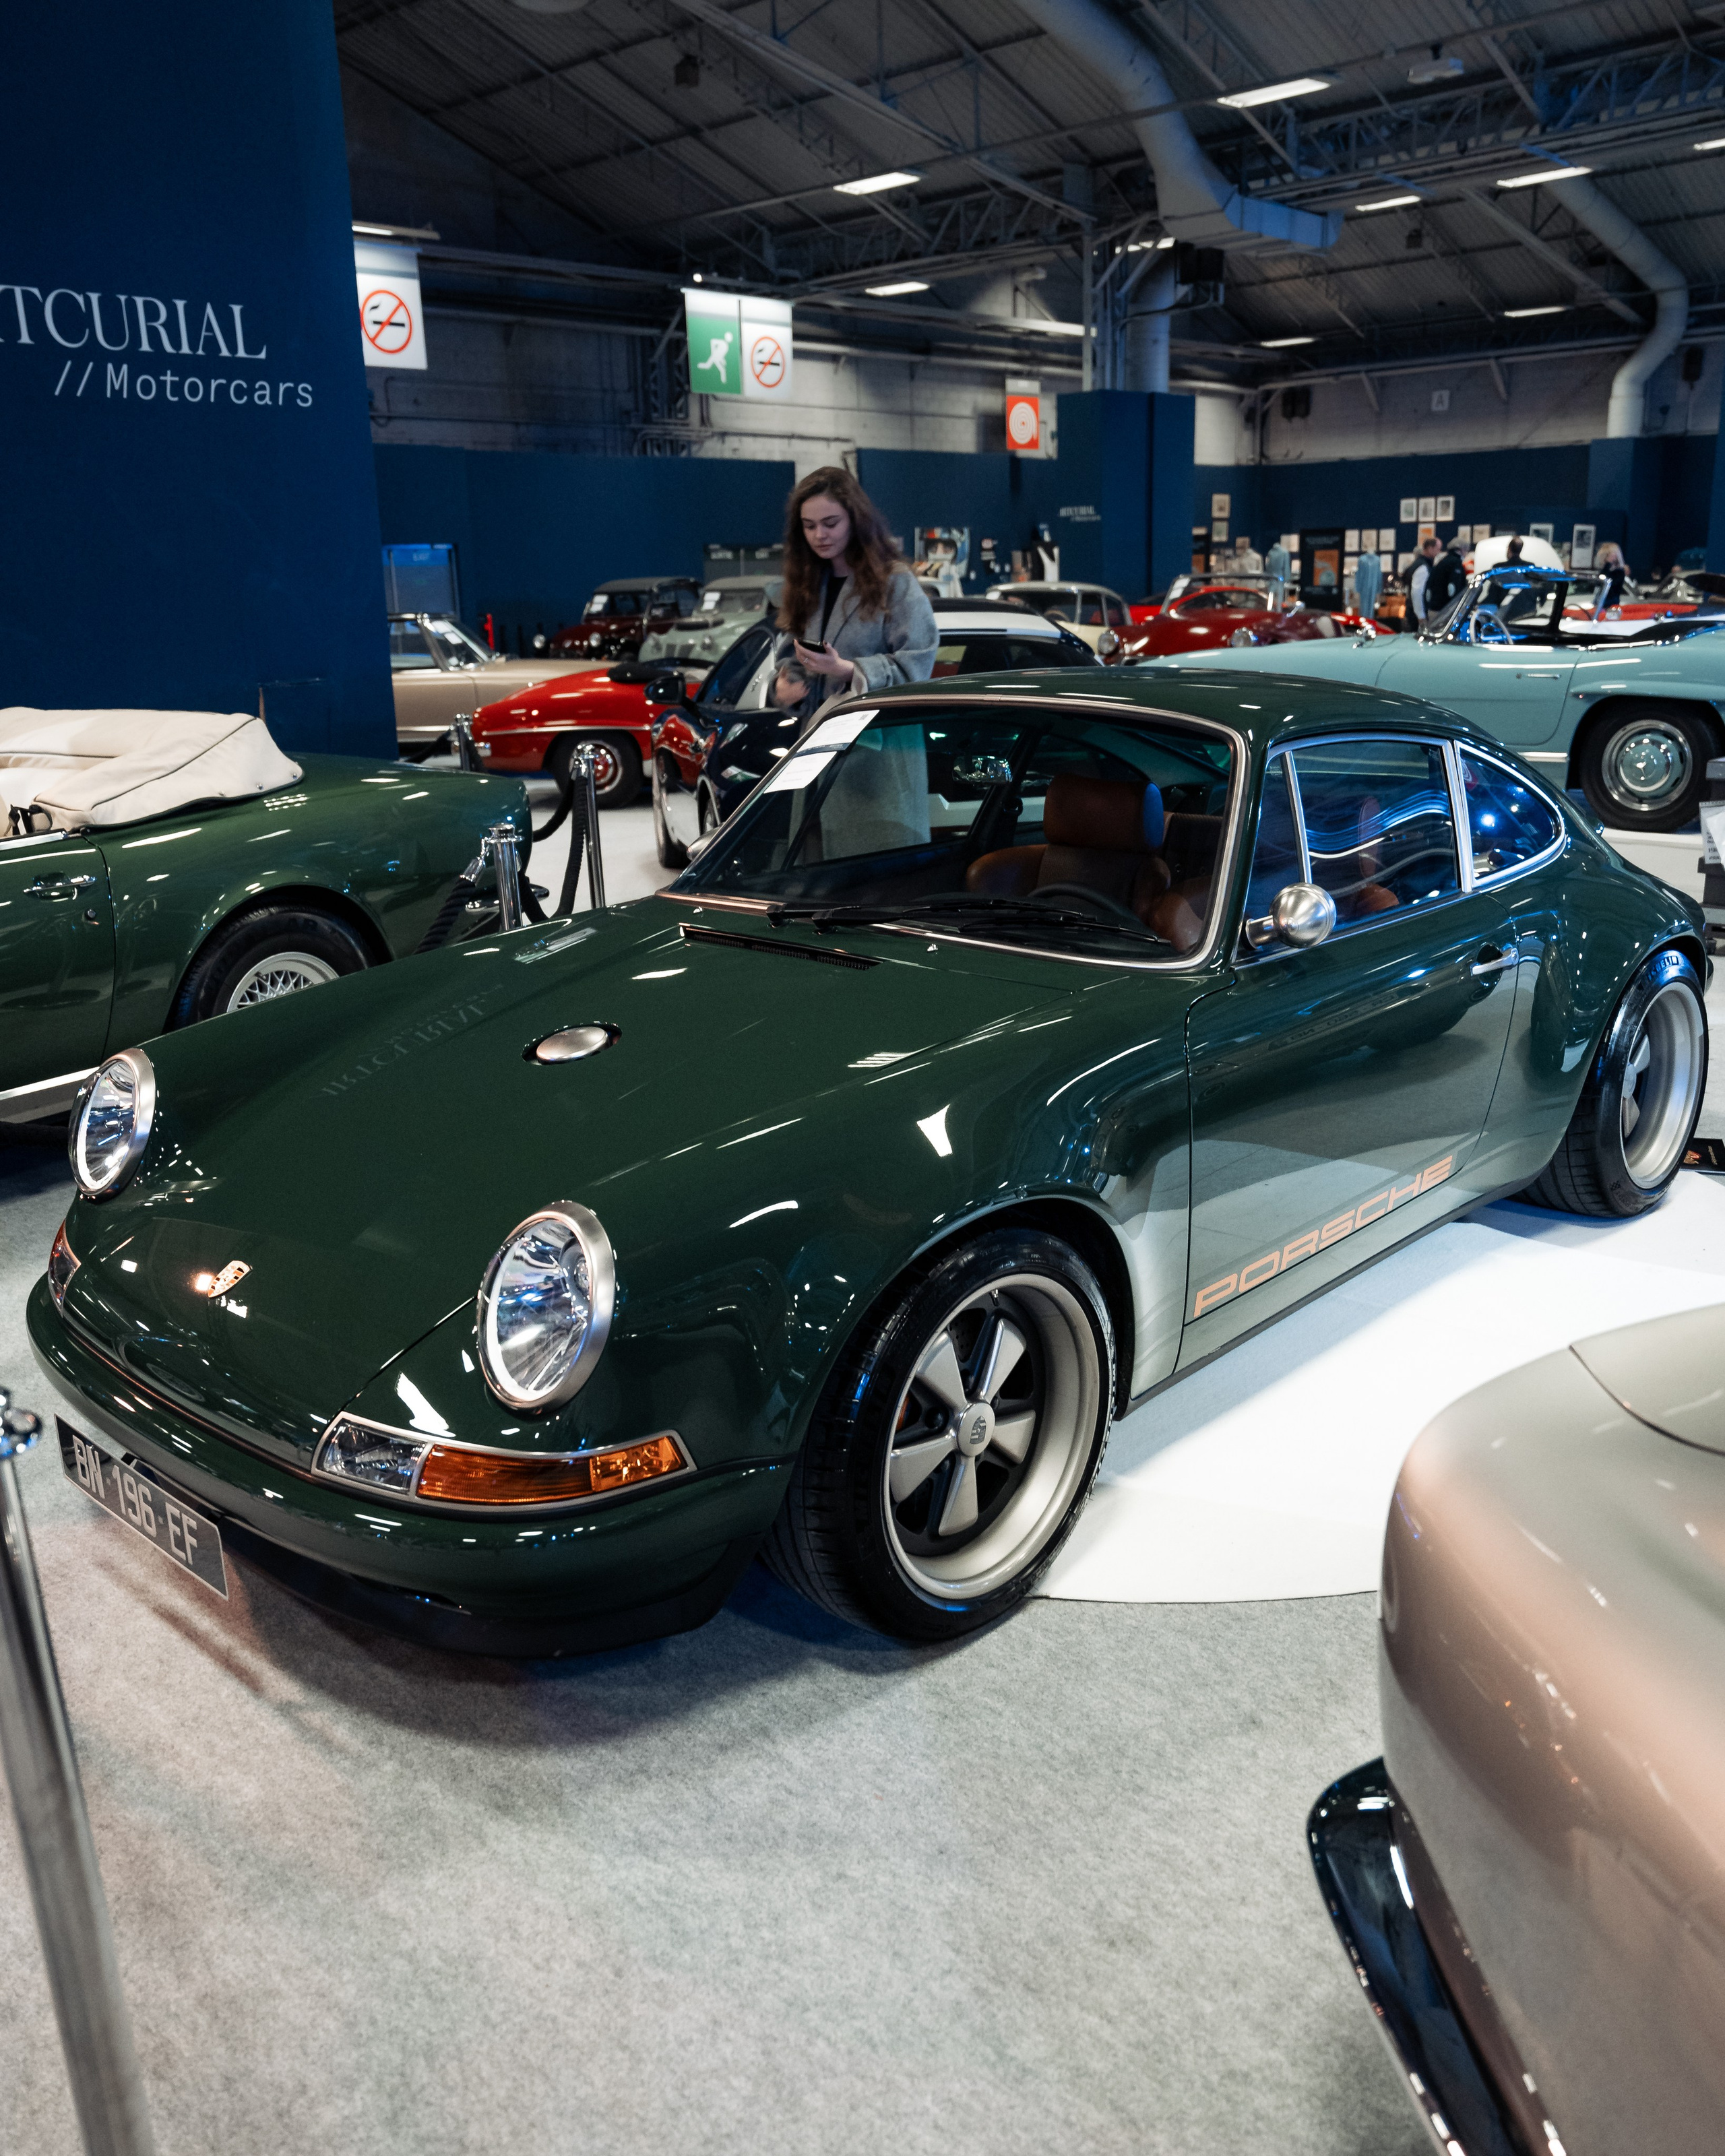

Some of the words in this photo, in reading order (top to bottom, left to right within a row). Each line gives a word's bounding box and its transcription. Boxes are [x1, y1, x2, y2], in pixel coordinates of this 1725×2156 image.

[0, 284, 267, 359] TCURIAL
[1193, 1155, 1453, 1319] PORSCHE
[72, 1435, 105, 1499] BN
[112, 1465, 157, 1537] 196
[165, 1502, 197, 1565] EF
